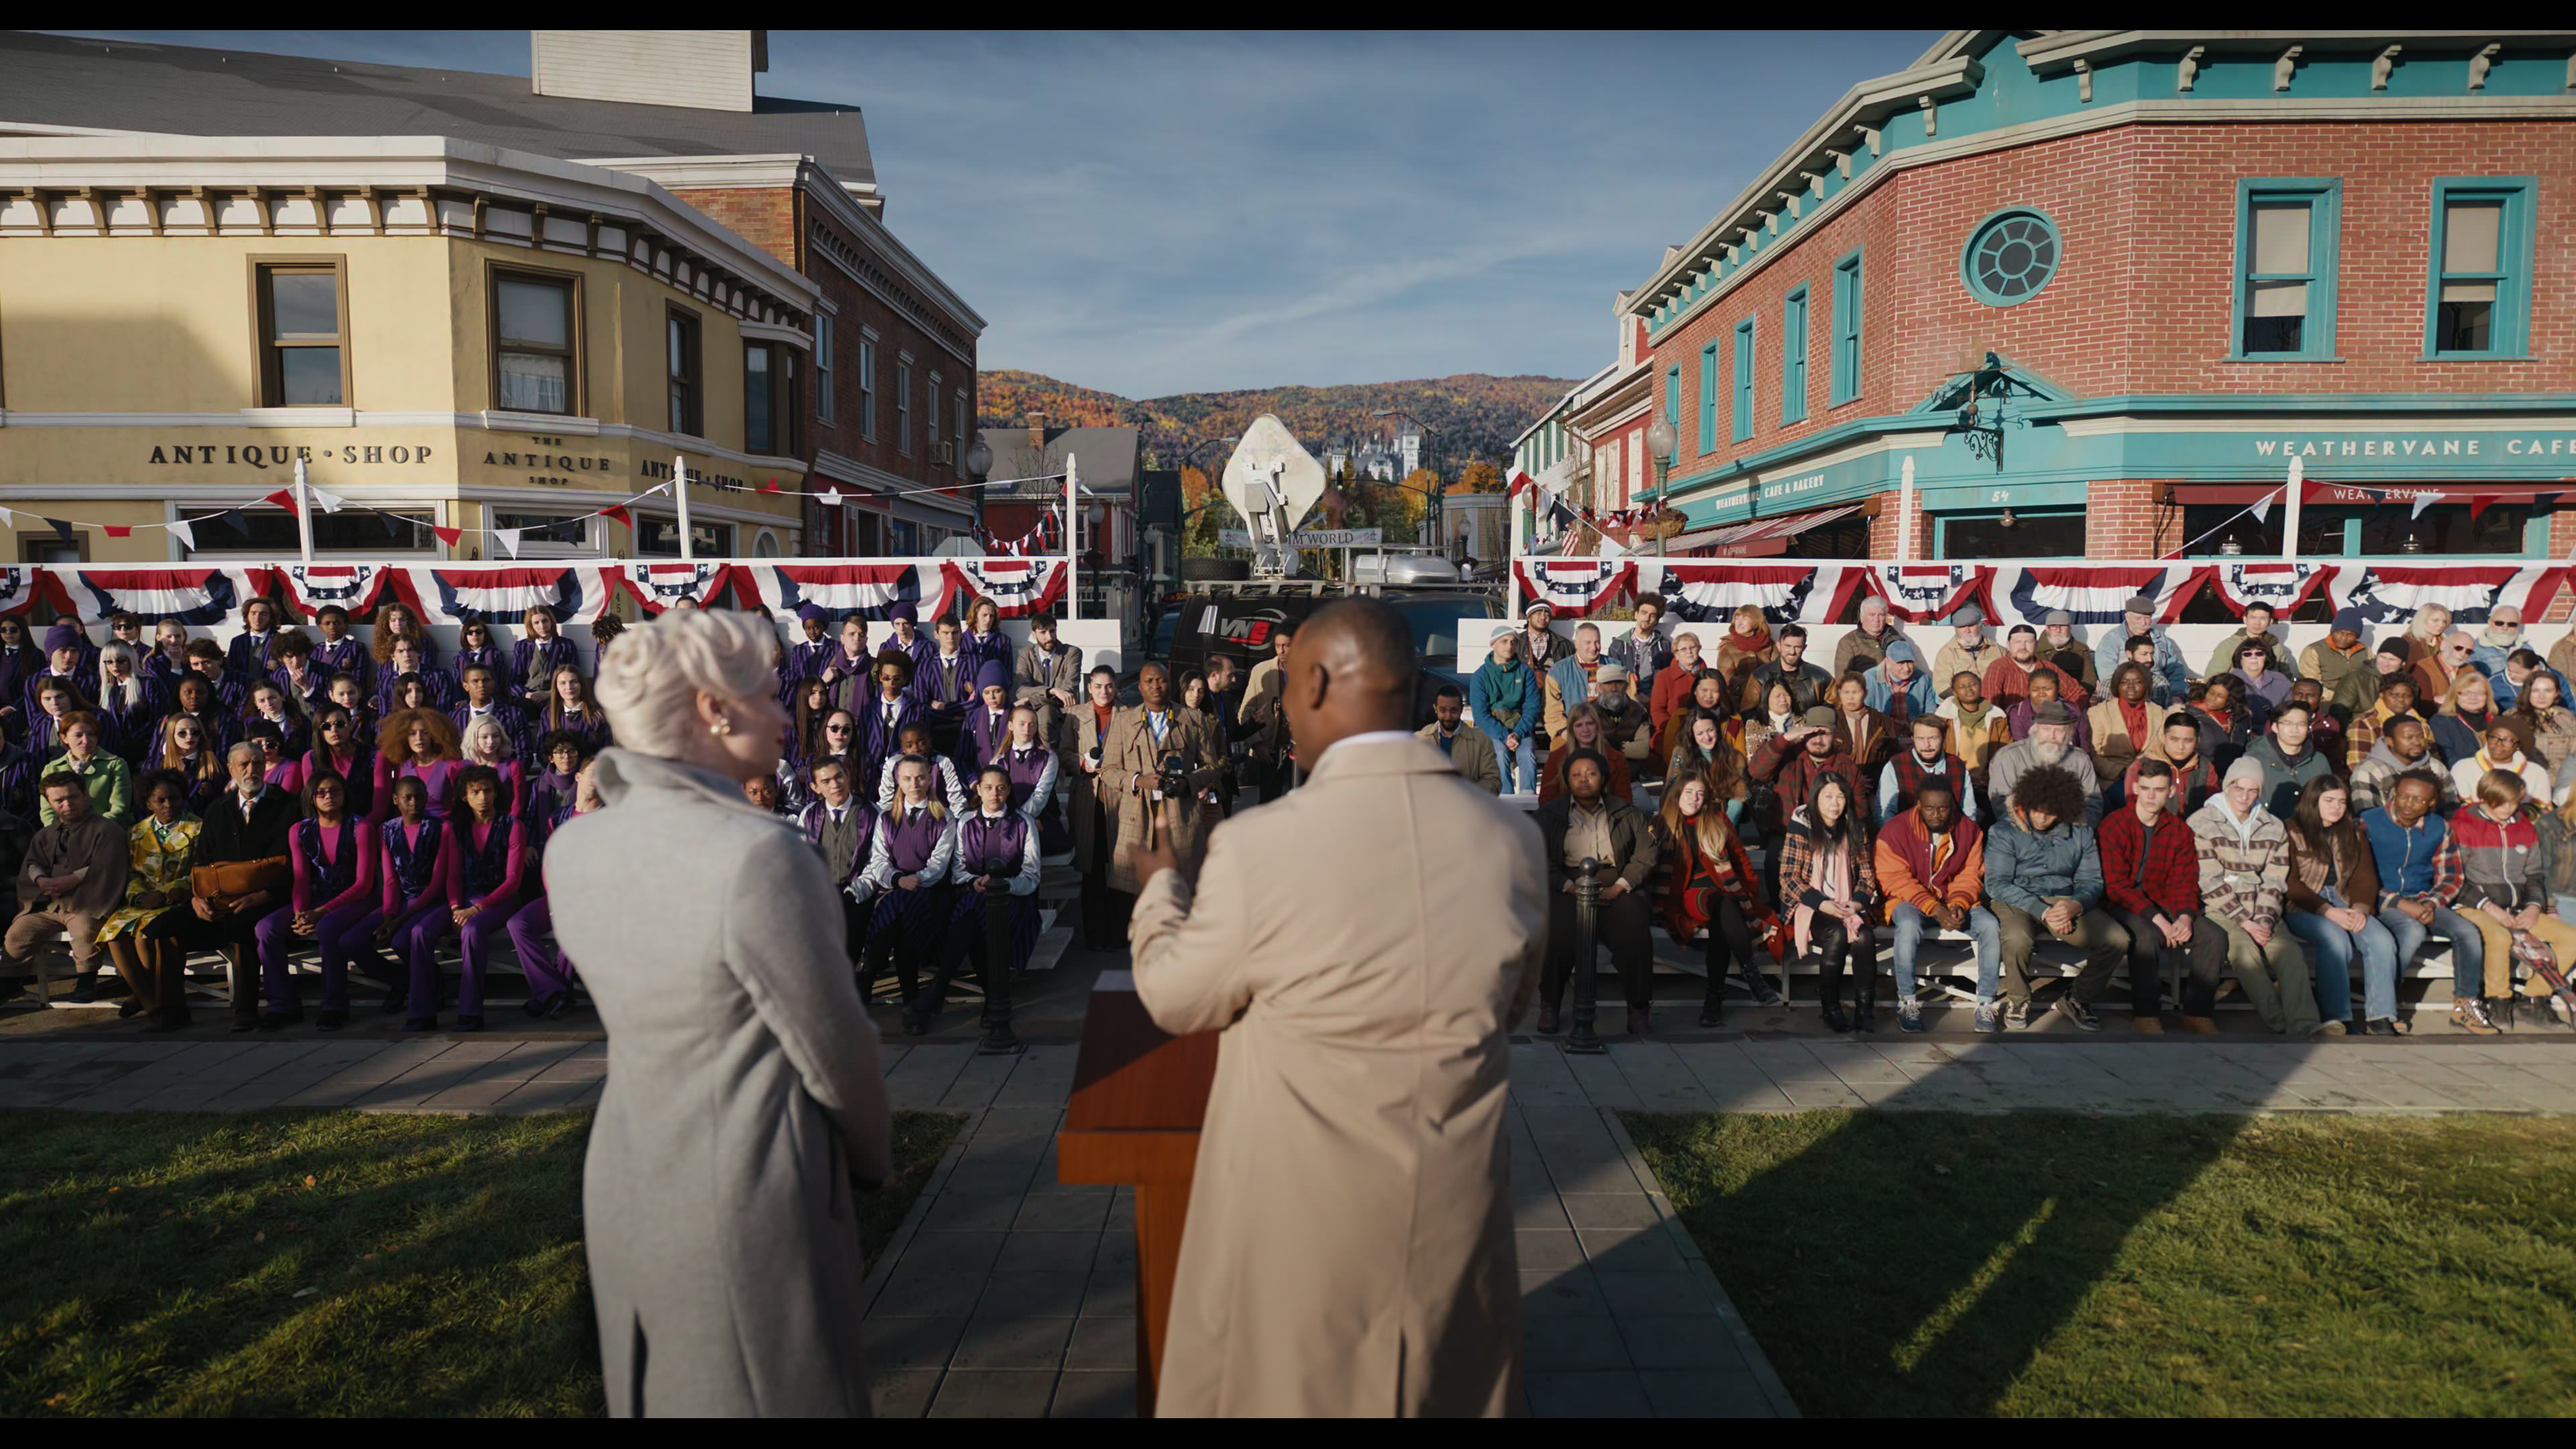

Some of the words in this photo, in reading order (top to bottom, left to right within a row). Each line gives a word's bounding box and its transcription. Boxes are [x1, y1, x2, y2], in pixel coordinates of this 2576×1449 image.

[532, 437, 562, 446] THE
[2255, 439, 2480, 456] WEATHERVANE
[2506, 439, 2576, 455] CAFE
[148, 445, 313, 469] ANTIQUE
[343, 445, 432, 464] SHOP
[483, 451, 610, 472] ANTIQUE
[529, 476, 568, 485] SHOP
[641, 460, 702, 485] ANTIUE
[714, 474, 743, 494] SHOP
[1765, 484, 1783, 498] CAFE
[1793, 474, 1824, 492] BAKERY
[1991, 490, 2009, 502] 54
[2333, 488, 2440, 500] WEAERVA
[1307, 532, 1354, 545] WORLD
